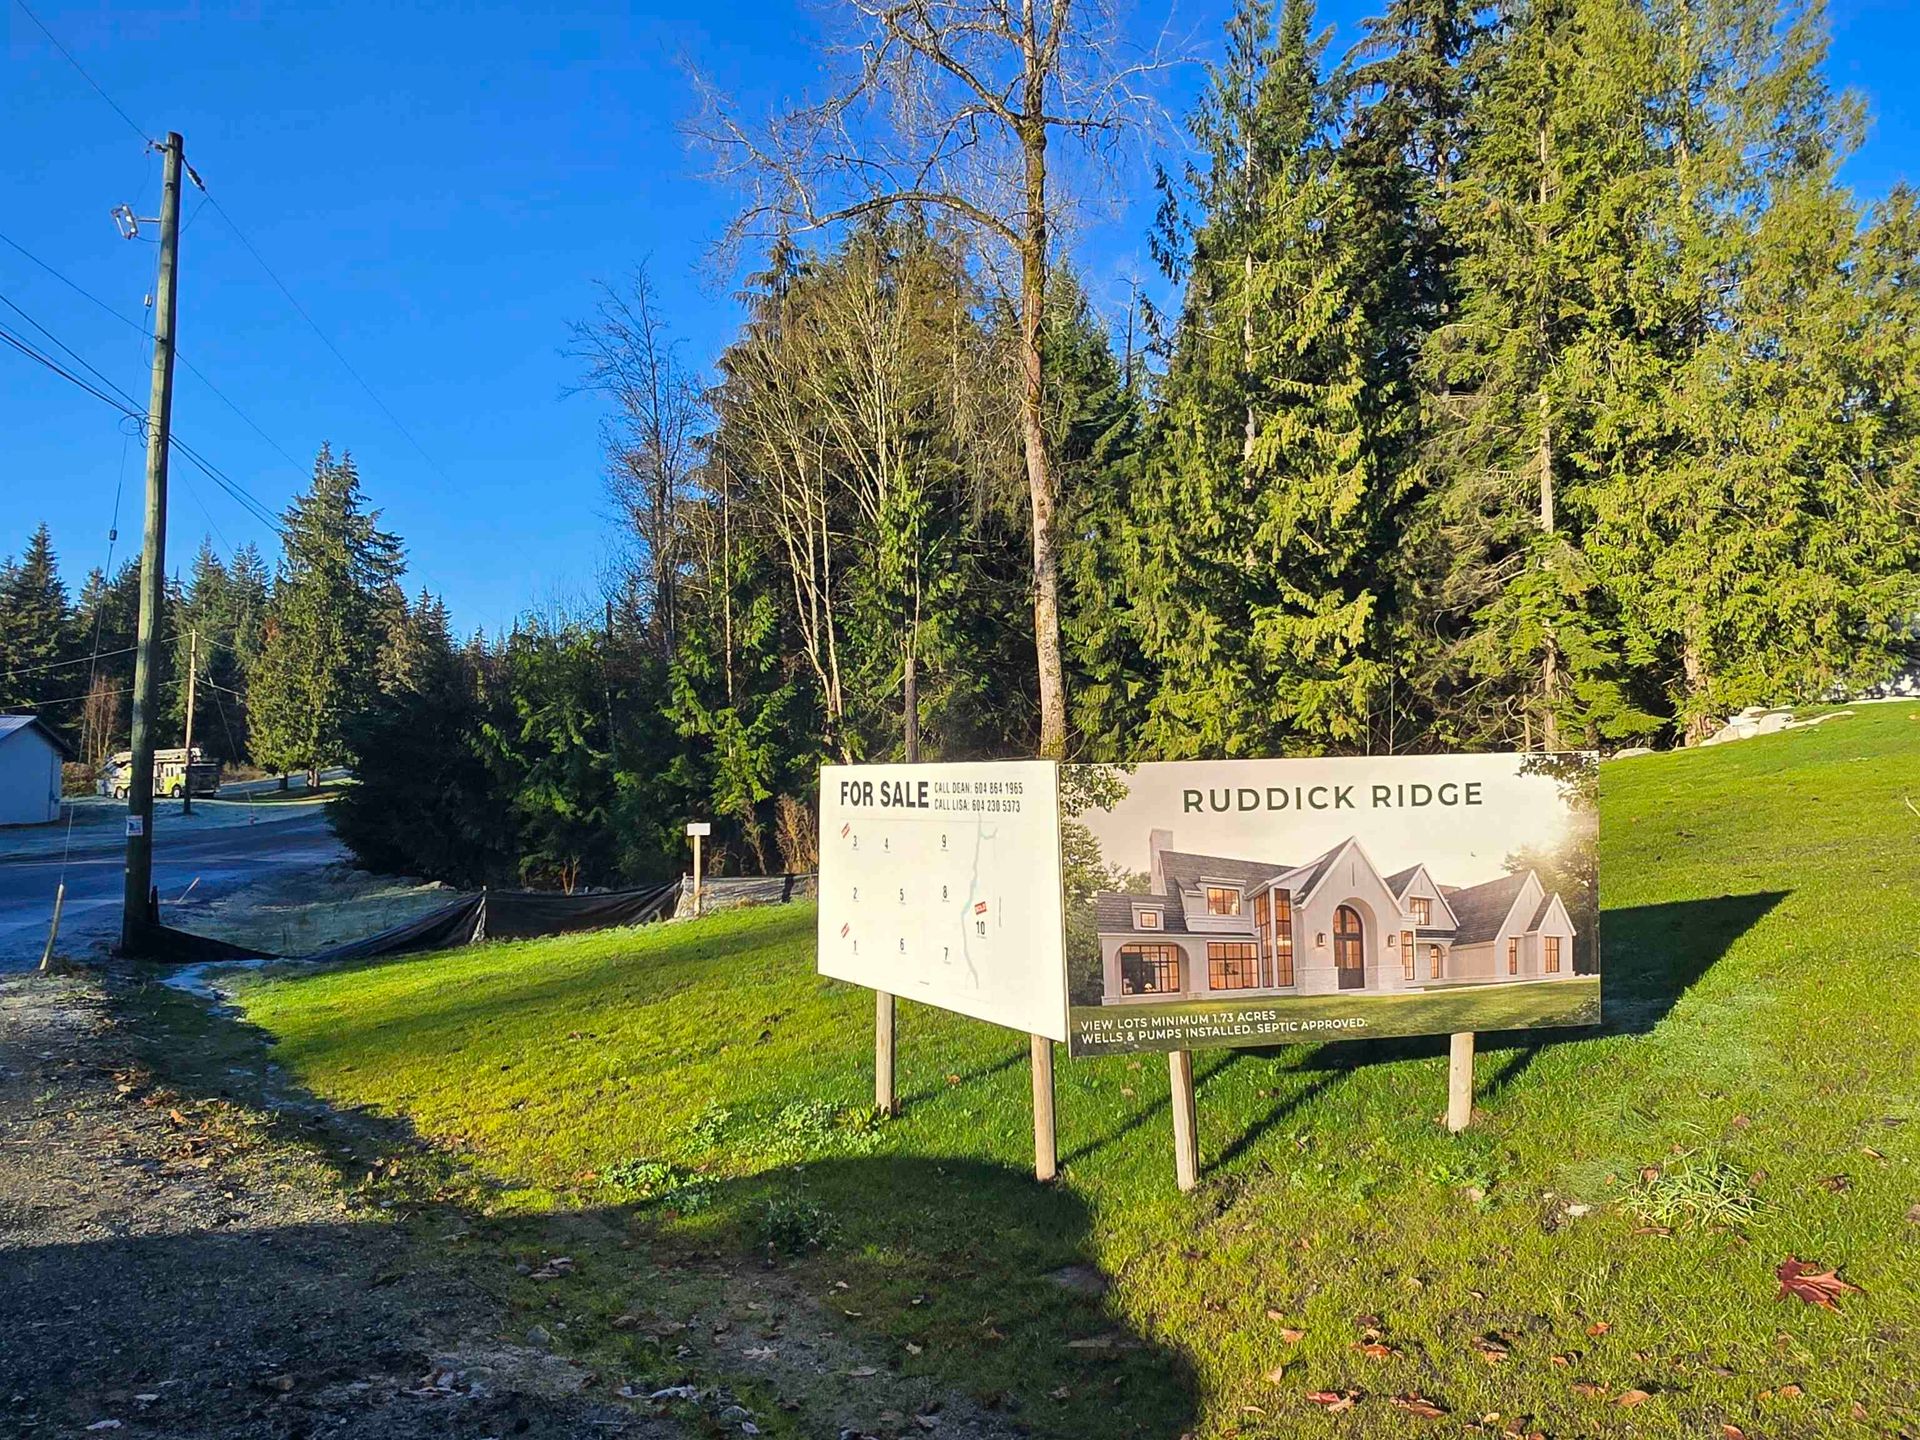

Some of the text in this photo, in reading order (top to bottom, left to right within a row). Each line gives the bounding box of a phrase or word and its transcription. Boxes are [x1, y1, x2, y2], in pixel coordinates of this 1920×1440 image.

[840, 781, 929, 809] FOR SALE
[934, 782, 1023, 795] CALL DEAN: 604 864 1965
[1183, 782, 1483, 813] RUDDICK RIDGE
[934, 798, 1021, 813] CALL LISA: 604 230 5373
[852, 835, 858, 847] 3
[941, 834, 947, 848] 9
[853, 887, 858, 899] 2
[899, 888, 904, 901] 5
[942, 885, 948, 899] 8
[976, 920, 986, 935] 10
[899, 938, 905, 951] 6
[944, 946, 949, 960] 7
[1081, 1010, 1276, 1032] VIEW LOTS MINIMUM 1.73 ACRES
[1081, 1017, 1369, 1044] WELLS & PUMPS INSTALLED. SEPTIC APPROVED.
